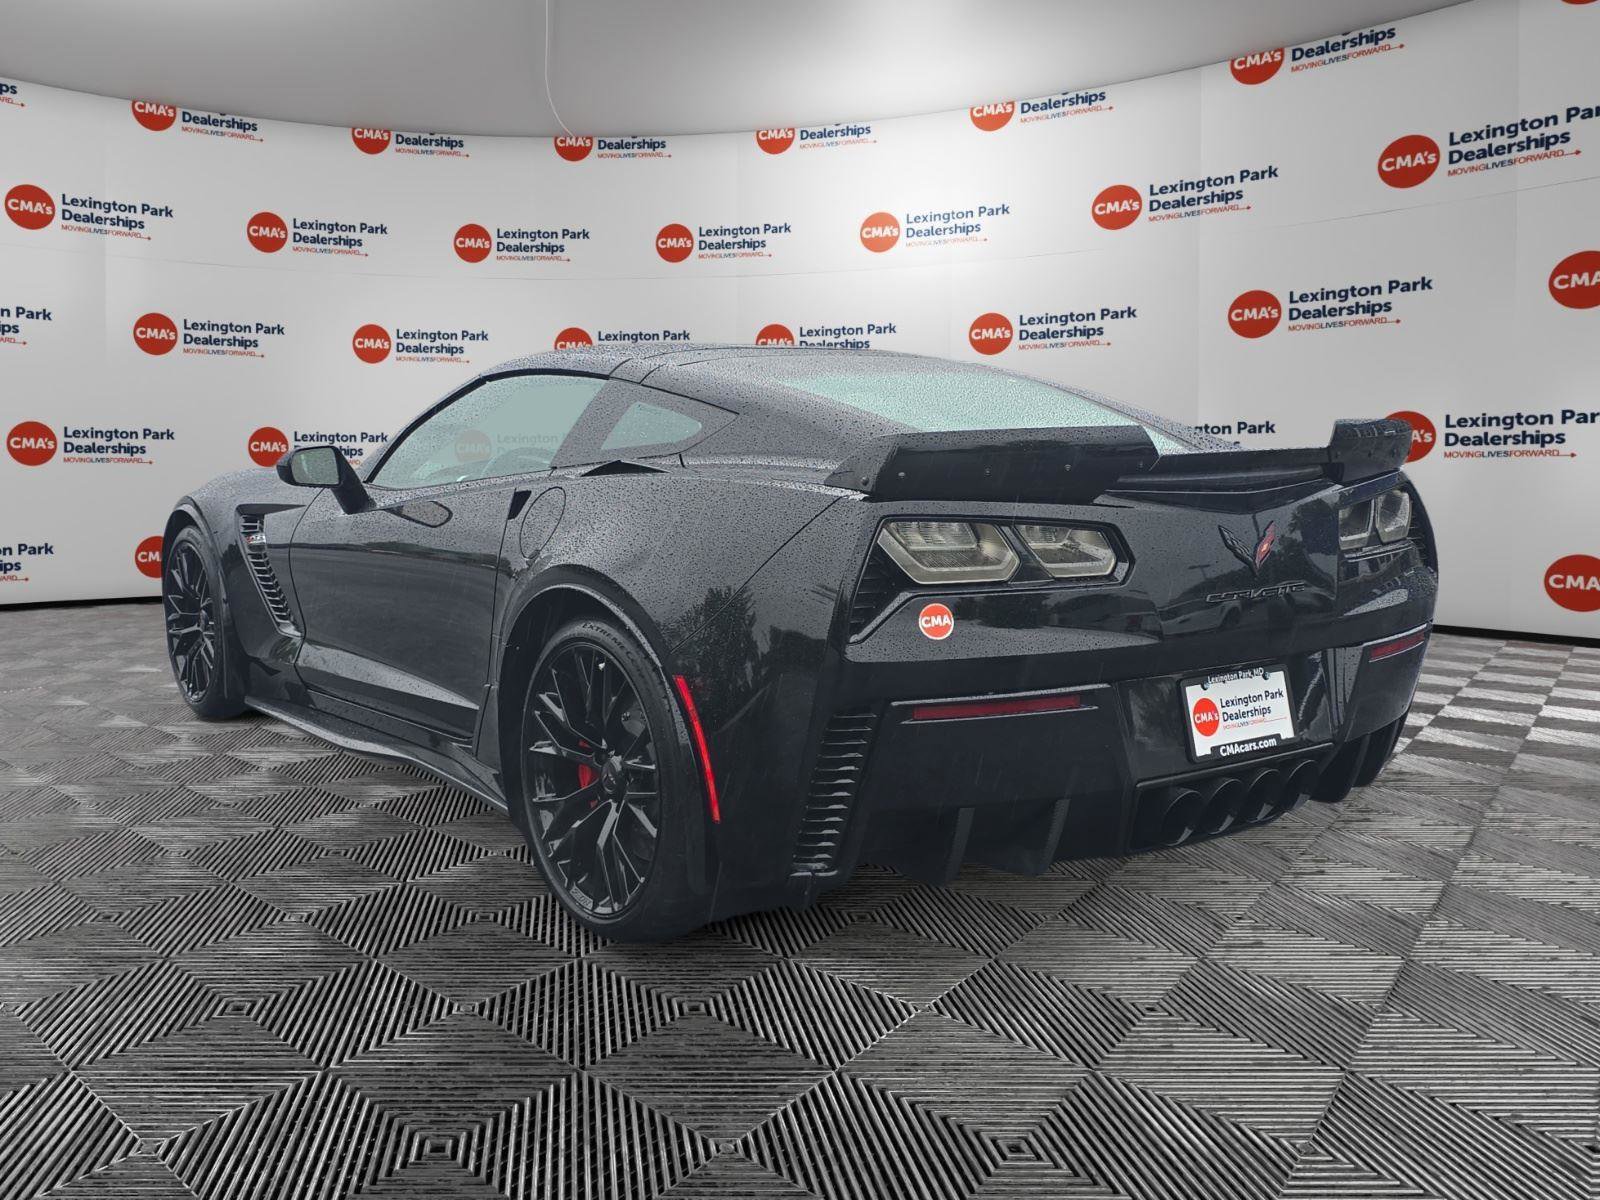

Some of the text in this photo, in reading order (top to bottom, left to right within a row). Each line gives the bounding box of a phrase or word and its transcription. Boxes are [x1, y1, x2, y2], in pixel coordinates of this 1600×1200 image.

[1292, 27, 1396, 62] Dealerships
[1234, 51, 1281, 70] CMA's
[1291, 44, 1391, 72] MOVINGLIVESFORWARD
[134, 101, 174, 117] CMA's
[1021, 90, 1106, 114] Dealerships
[972, 103, 1013, 118] CMA's
[182, 111, 258, 132] Dealerships
[1449, 106, 1600, 146] Lexington Par
[354, 128, 389, 141] CMA's
[758, 129, 794, 141] CMA's
[800, 125, 871, 140] Dealerships
[395, 134, 464, 149] Dealerships
[557, 136, 591, 148] CMA's
[598, 138, 666, 151] Dealerships
[1448, 130, 1571, 165] Dealerships
[1381, 151, 1438, 172] CMA's
[1448, 150, 1565, 176] MOVINGLIVESFORWARD
[1150, 166, 1278, 196] Lexington Park
[8, 198, 53, 215] CMA's
[62, 193, 173, 218] Lexington Park
[1094, 200, 1140, 215] CMA's
[1149, 189, 1243, 212] Dealerships
[61, 209, 145, 230] Dealerships
[906, 205, 1010, 224] Lexington Park
[1149, 204, 1239, 222] MOVINGLIVESFORWARD
[249, 226, 286, 239] CMA's
[293, 218, 388, 235] Lexington Park
[699, 223, 791, 238] Lexington Park
[861, 226, 899, 239] CMA's
[906, 222, 981, 238] Dealerships
[292, 232, 362, 248] Dealerships
[497, 228, 590, 241] Lexington Park
[456, 238, 490, 249] CMA's
[497, 242, 565, 253] Dealerships
[658, 238, 692, 249] CMA's
[699, 238, 766, 251] Dealerships
[1289, 277, 1432, 303] Lexington Park
[16, 306, 52, 321] Park
[1019, 307, 1137, 327] Lexington Park
[1231, 306, 1278, 321] CMA's
[1289, 301, 1392, 320] Dealerships
[183, 319, 285, 336] Lexington Park
[800, 323, 896, 339] Lexington Park
[1288, 317, 1387, 331] MOVINGLIVESFORWARD
[136, 327, 176, 340] CMA's
[396, 329, 488, 343] Lexington Park
[598, 330, 690, 343] Lexington Park
[971, 327, 1011, 340] CMA's
[1019, 326, 1104, 340] Dealerships
[183, 334, 258, 348] Dealerships
[355, 338, 389, 350] CMA's
[396, 342, 464, 355] Dealerships
[1445, 409, 1600, 429] Lexington Par
[64, 426, 174, 442] Lexington Park
[1237, 421, 1276, 434] Park
[9, 437, 54, 449] CMA's
[294, 431, 388, 444] Lexington Park
[1411, 430, 1433, 443] A's
[1444, 430, 1565, 449] Dealerships
[64, 442, 146, 456] Dealerships
[251, 442, 287, 452] CMA's
[1444, 449, 1560, 459] MOVINGLIVESFORWARD
[18, 542, 54, 556] Park
[1549, 574, 1600, 591] CMA
[921, 614, 952, 628] CMA
[1208, 673, 1238, 684] Lexington
[1220, 689, 1284, 708] Lexington Park
[1195, 711, 1219, 723] CMA's
[1222, 706, 1271, 722] Dealerships
[1220, 738, 1276, 756] CMAcars.com
